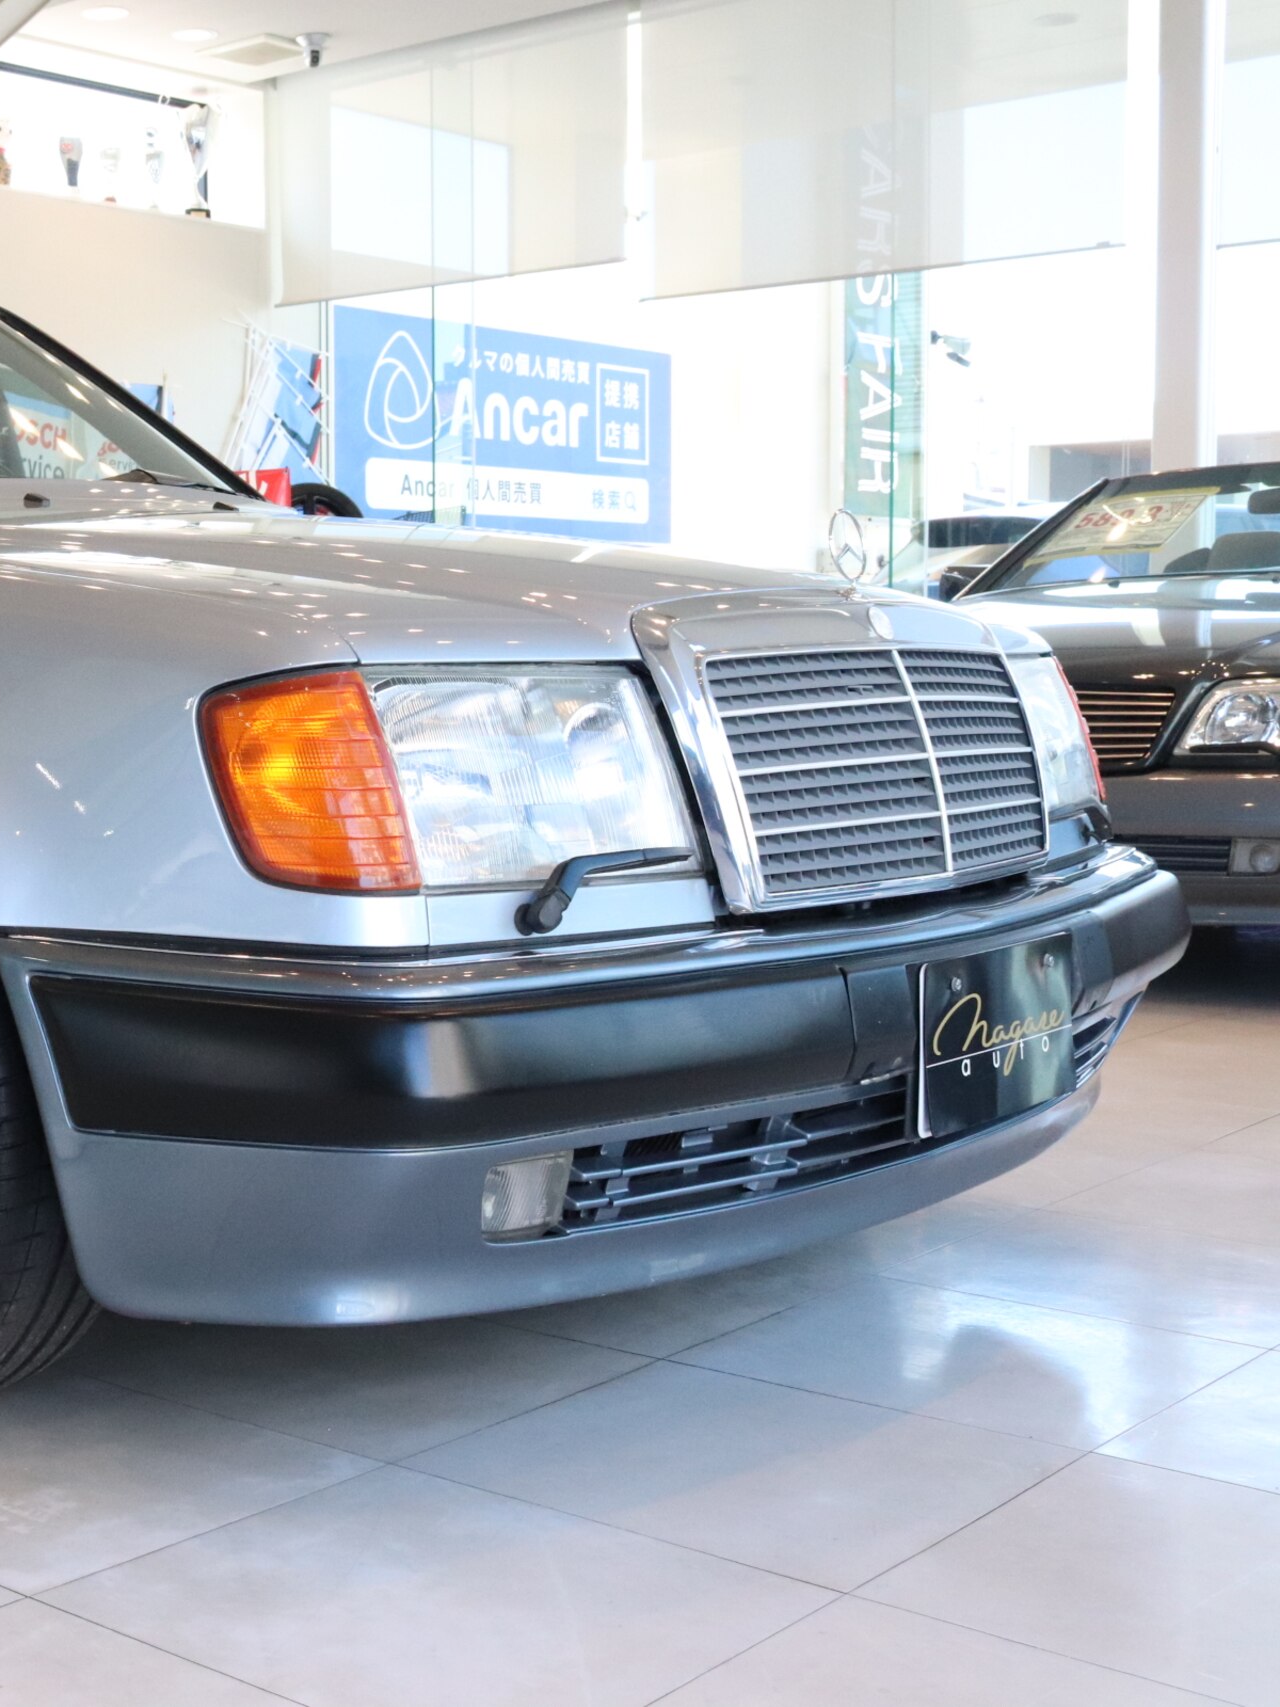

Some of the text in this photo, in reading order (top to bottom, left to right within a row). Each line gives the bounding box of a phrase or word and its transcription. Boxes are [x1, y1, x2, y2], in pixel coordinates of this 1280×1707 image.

[451, 345, 590, 385] クルマの個人間売買
[449, 377, 589, 448] Ancar
[604, 378, 640, 411] 提携
[856, 331, 903, 494] FAIR
[604, 420, 641, 450] 店舗
[401, 474, 620, 510] Ancar 個人間売買 検索
[961, 1035, 1050, 1076] auto
